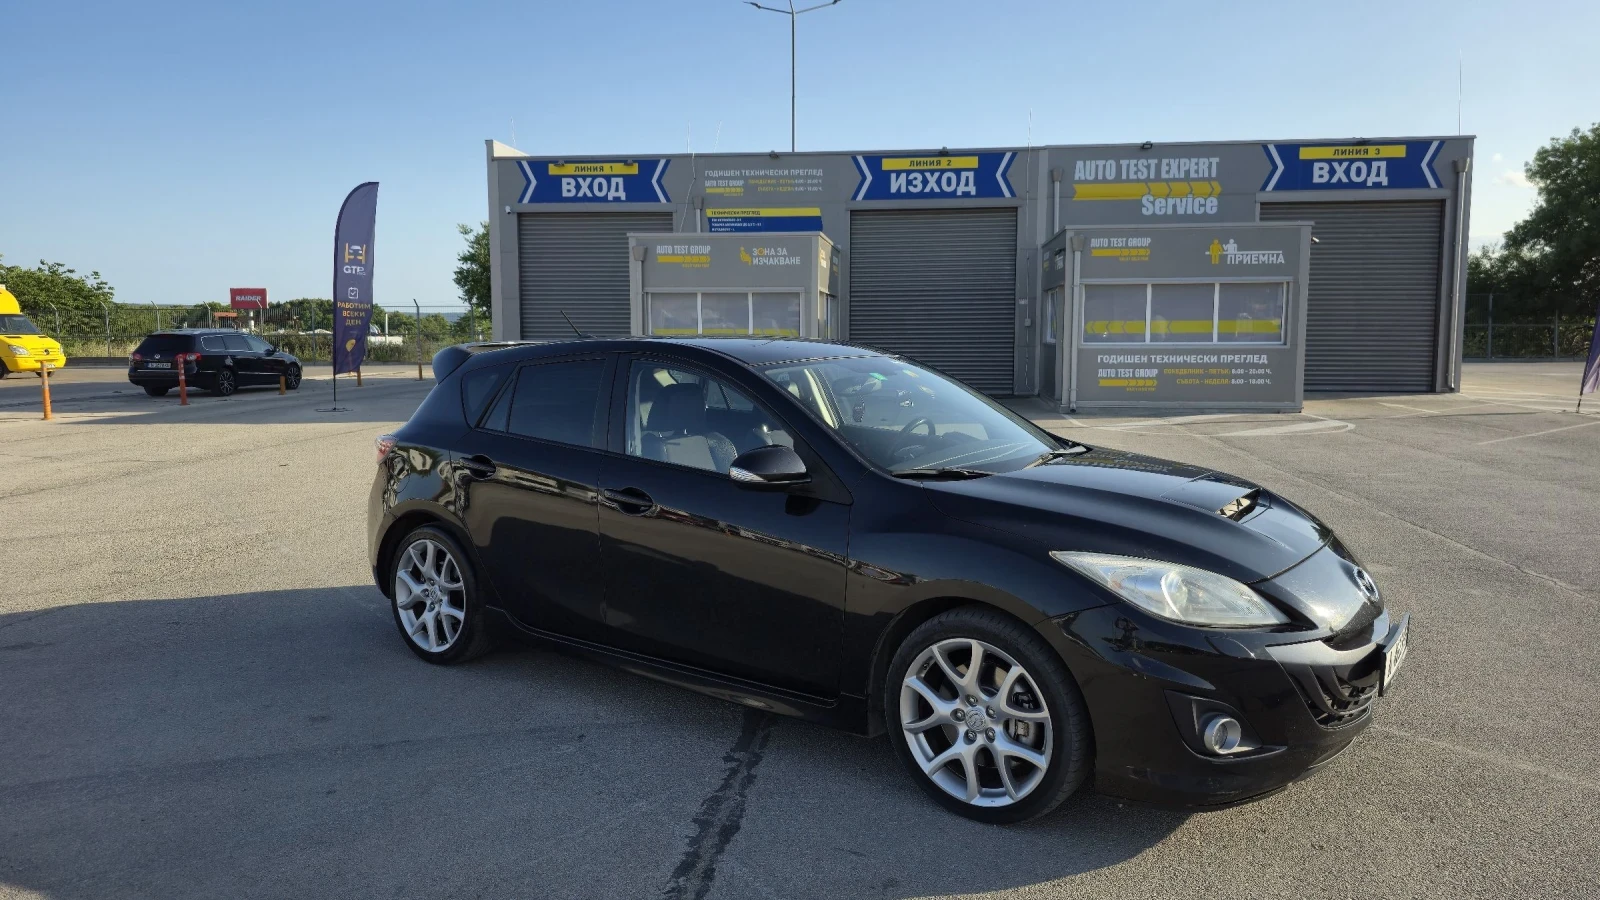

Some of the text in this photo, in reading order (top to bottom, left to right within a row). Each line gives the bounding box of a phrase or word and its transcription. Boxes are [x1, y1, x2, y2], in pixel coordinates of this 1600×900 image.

[1074, 158, 1219, 180] AUTO TEST EXPERT
[1312, 160, 1388, 186] ВХОД
[890, 171, 976, 196] ИЗХОД
[562, 178, 626, 200] ВХОД
[1142, 194, 1218, 215] Service
[1091, 238, 1151, 247] AUTO TEST GROUP
[656, 245, 711, 254] AUTO TEST GROUP
[752, 248, 775, 256] ЗОНА
[752, 256, 800, 265] ИЗЧАКВАНЕ
[1227, 254, 1285, 265] ПРИЕМНА
[343, 266, 364, 274] GTP
[1098, 355, 1268, 364] ГОДИШЕН ТЕХНИЧЕСКИ ПРЕГЛЕД
[1098, 369, 1158, 378] AUTO TEST GROUP
